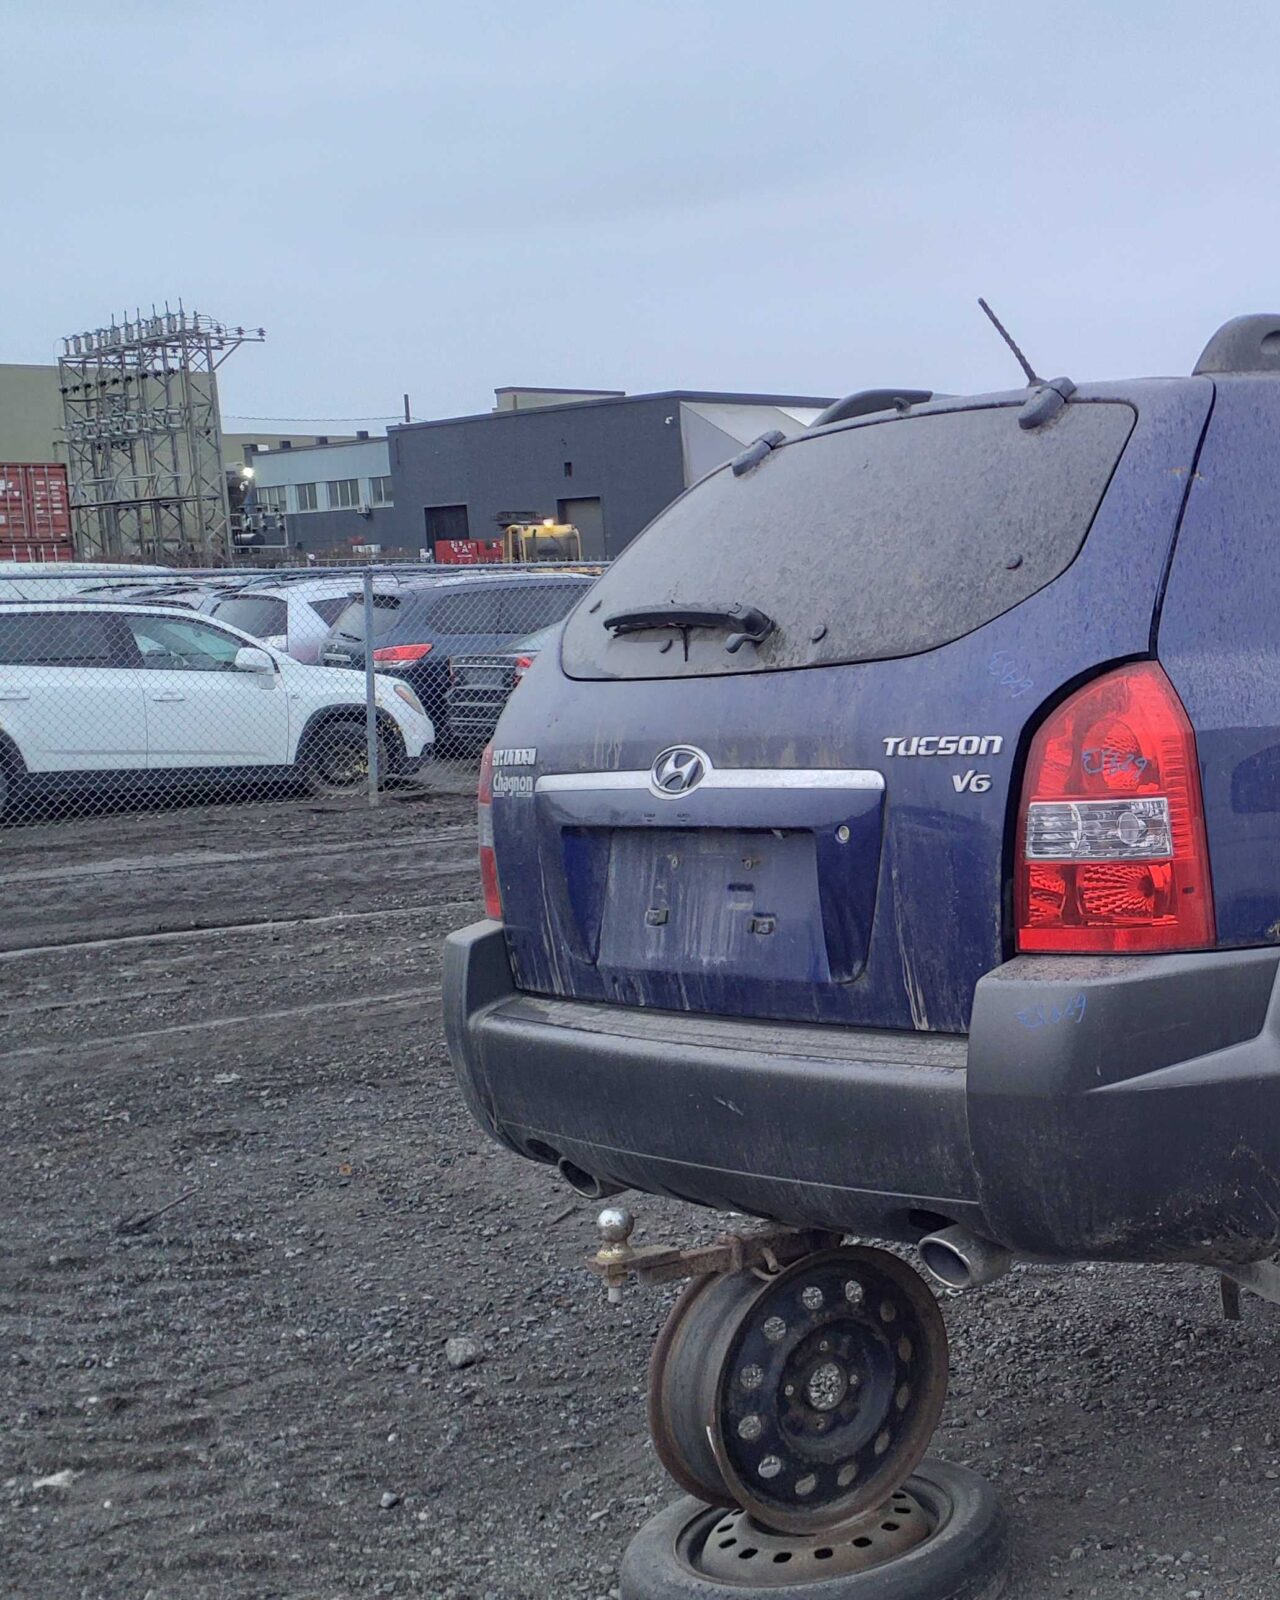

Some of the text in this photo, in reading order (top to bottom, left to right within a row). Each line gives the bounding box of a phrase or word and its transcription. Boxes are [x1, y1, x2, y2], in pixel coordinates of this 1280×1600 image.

[882, 735, 1003, 756] TUCSON
[493, 770, 533, 796] Chagnon
[952, 769, 992, 793] V6
